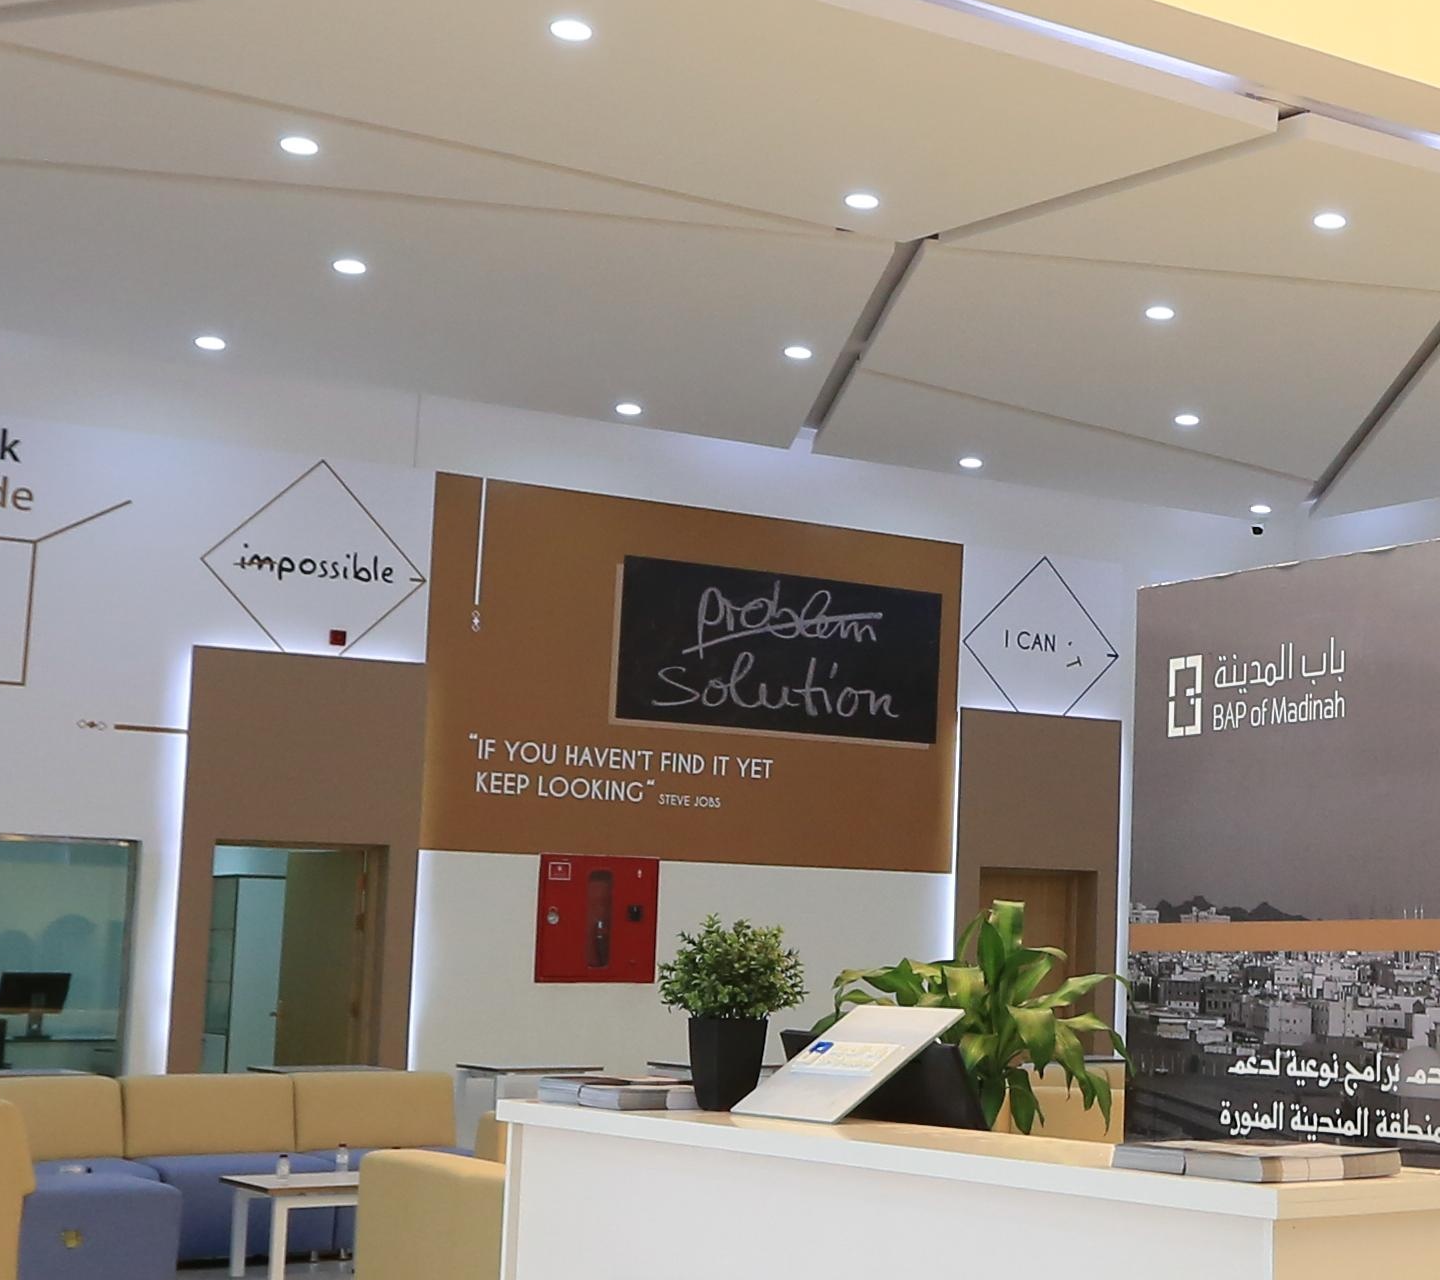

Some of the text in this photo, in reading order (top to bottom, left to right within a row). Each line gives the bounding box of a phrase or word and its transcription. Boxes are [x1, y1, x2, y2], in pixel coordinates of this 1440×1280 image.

[236, 543, 394, 584] impossible
[1016, 630, 1056, 652] CAN
[1214, 636, 1345, 694] باب المدينة
[1212, 690, 1345, 731] BAP of Madinah
[504, 740, 557, 765] YOU
[565, 744, 654, 771] HAVEN'T
[660, 751, 705, 774] FIND
[712, 755, 730, 776] IT
[735, 757, 774, 779] YET
[475, 771, 530, 795] KEEP
[658, 794, 691, 807] STEVE
[693, 795, 721, 808] JOBS
[1227, 1047, 1281, 1076] لدعم
[1285, 1049, 1339, 1088] نوعية
[1343, 1050, 1400, 1096] برامج
[1219, 1099, 1285, 1137] المنورة
